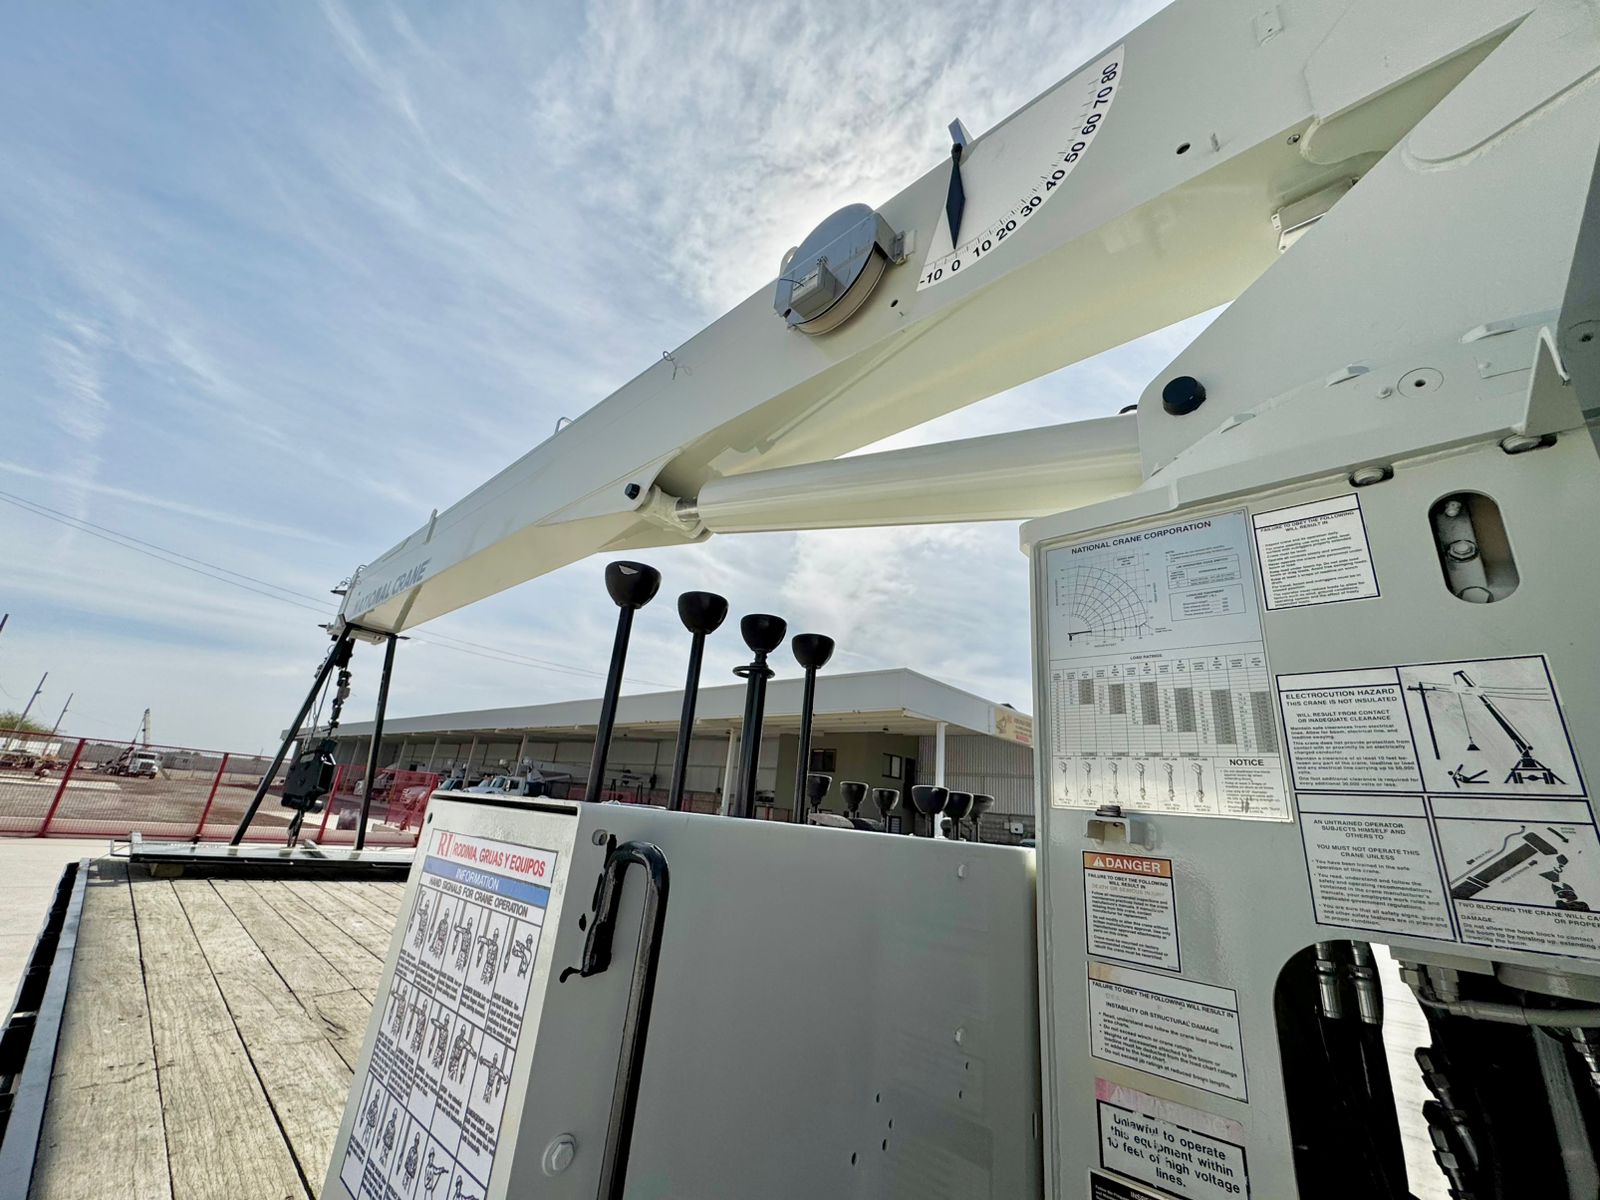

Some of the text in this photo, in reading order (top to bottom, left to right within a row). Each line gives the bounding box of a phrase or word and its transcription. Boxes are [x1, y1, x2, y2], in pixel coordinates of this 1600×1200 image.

[919, 62, 1118, 284] -10 0 10 20 30 40 50 60 70 80
[1071, 519, 1212, 555] NATIONAL CRANE CORPORATION
[391, 557, 432, 595] CRANE
[1285, 688, 1395, 699] ELECTROCUTION HAZARD
[1228, 758, 1264, 766] NOTICE
[1367, 846, 1401, 854] OPERATE
[479, 848, 503, 867] GRUAS
[504, 854, 510, 869] Y
[509, 855, 546, 877] EQUIPOS
[1105, 857, 1161, 873] DANGER
[455, 868, 500, 891] INFORMATION
[1138, 878, 1168, 887] FOLLOWING
[1347, 880, 1376, 888] operating
[1376, 883, 1433, 894] recommendations
[428, 876, 529, 918] HAND SIGNALS FOR CRANE OPERATION
[1475, 903, 1515, 912] BLOCKING
[1534, 909, 1562, 917] CRANE
[1564, 912, 1585, 920] WILL
[1566, 934, 1593, 942] contact
[1092, 981, 1113, 990] FAILURE
[1122, 987, 1137, 996] OBEY
[1138, 991, 1149, 999] THE
[1150, 994, 1185, 1007] FOLLOWING
[1186, 1002, 1201, 1011] WILL
[1201, 1005, 1225, 1016] RESULT
[1105, 1000, 1139, 1014] INSTABILITY
[1149, 1011, 1190, 1027] STRUCTURAL
[1190, 1021, 1218, 1034] DAMAGE
[1116, 1015, 1143, 1027] understand
[1153, 1025, 1169, 1033] follow
[1179, 1031, 1194, 1040] crane
[1119, 1027, 1136, 1037] exceed
[1137, 1032, 1152, 1041] winch
[1158, 1038, 1173, 1047] crane
[1163, 1130, 1175, 1143] to
[1180, 1138, 1226, 1161] operate
[1156, 1167, 1187, 1188] lines.
[1198, 1156, 1234, 1178] within
[1194, 1170, 1240, 1194] voltage
